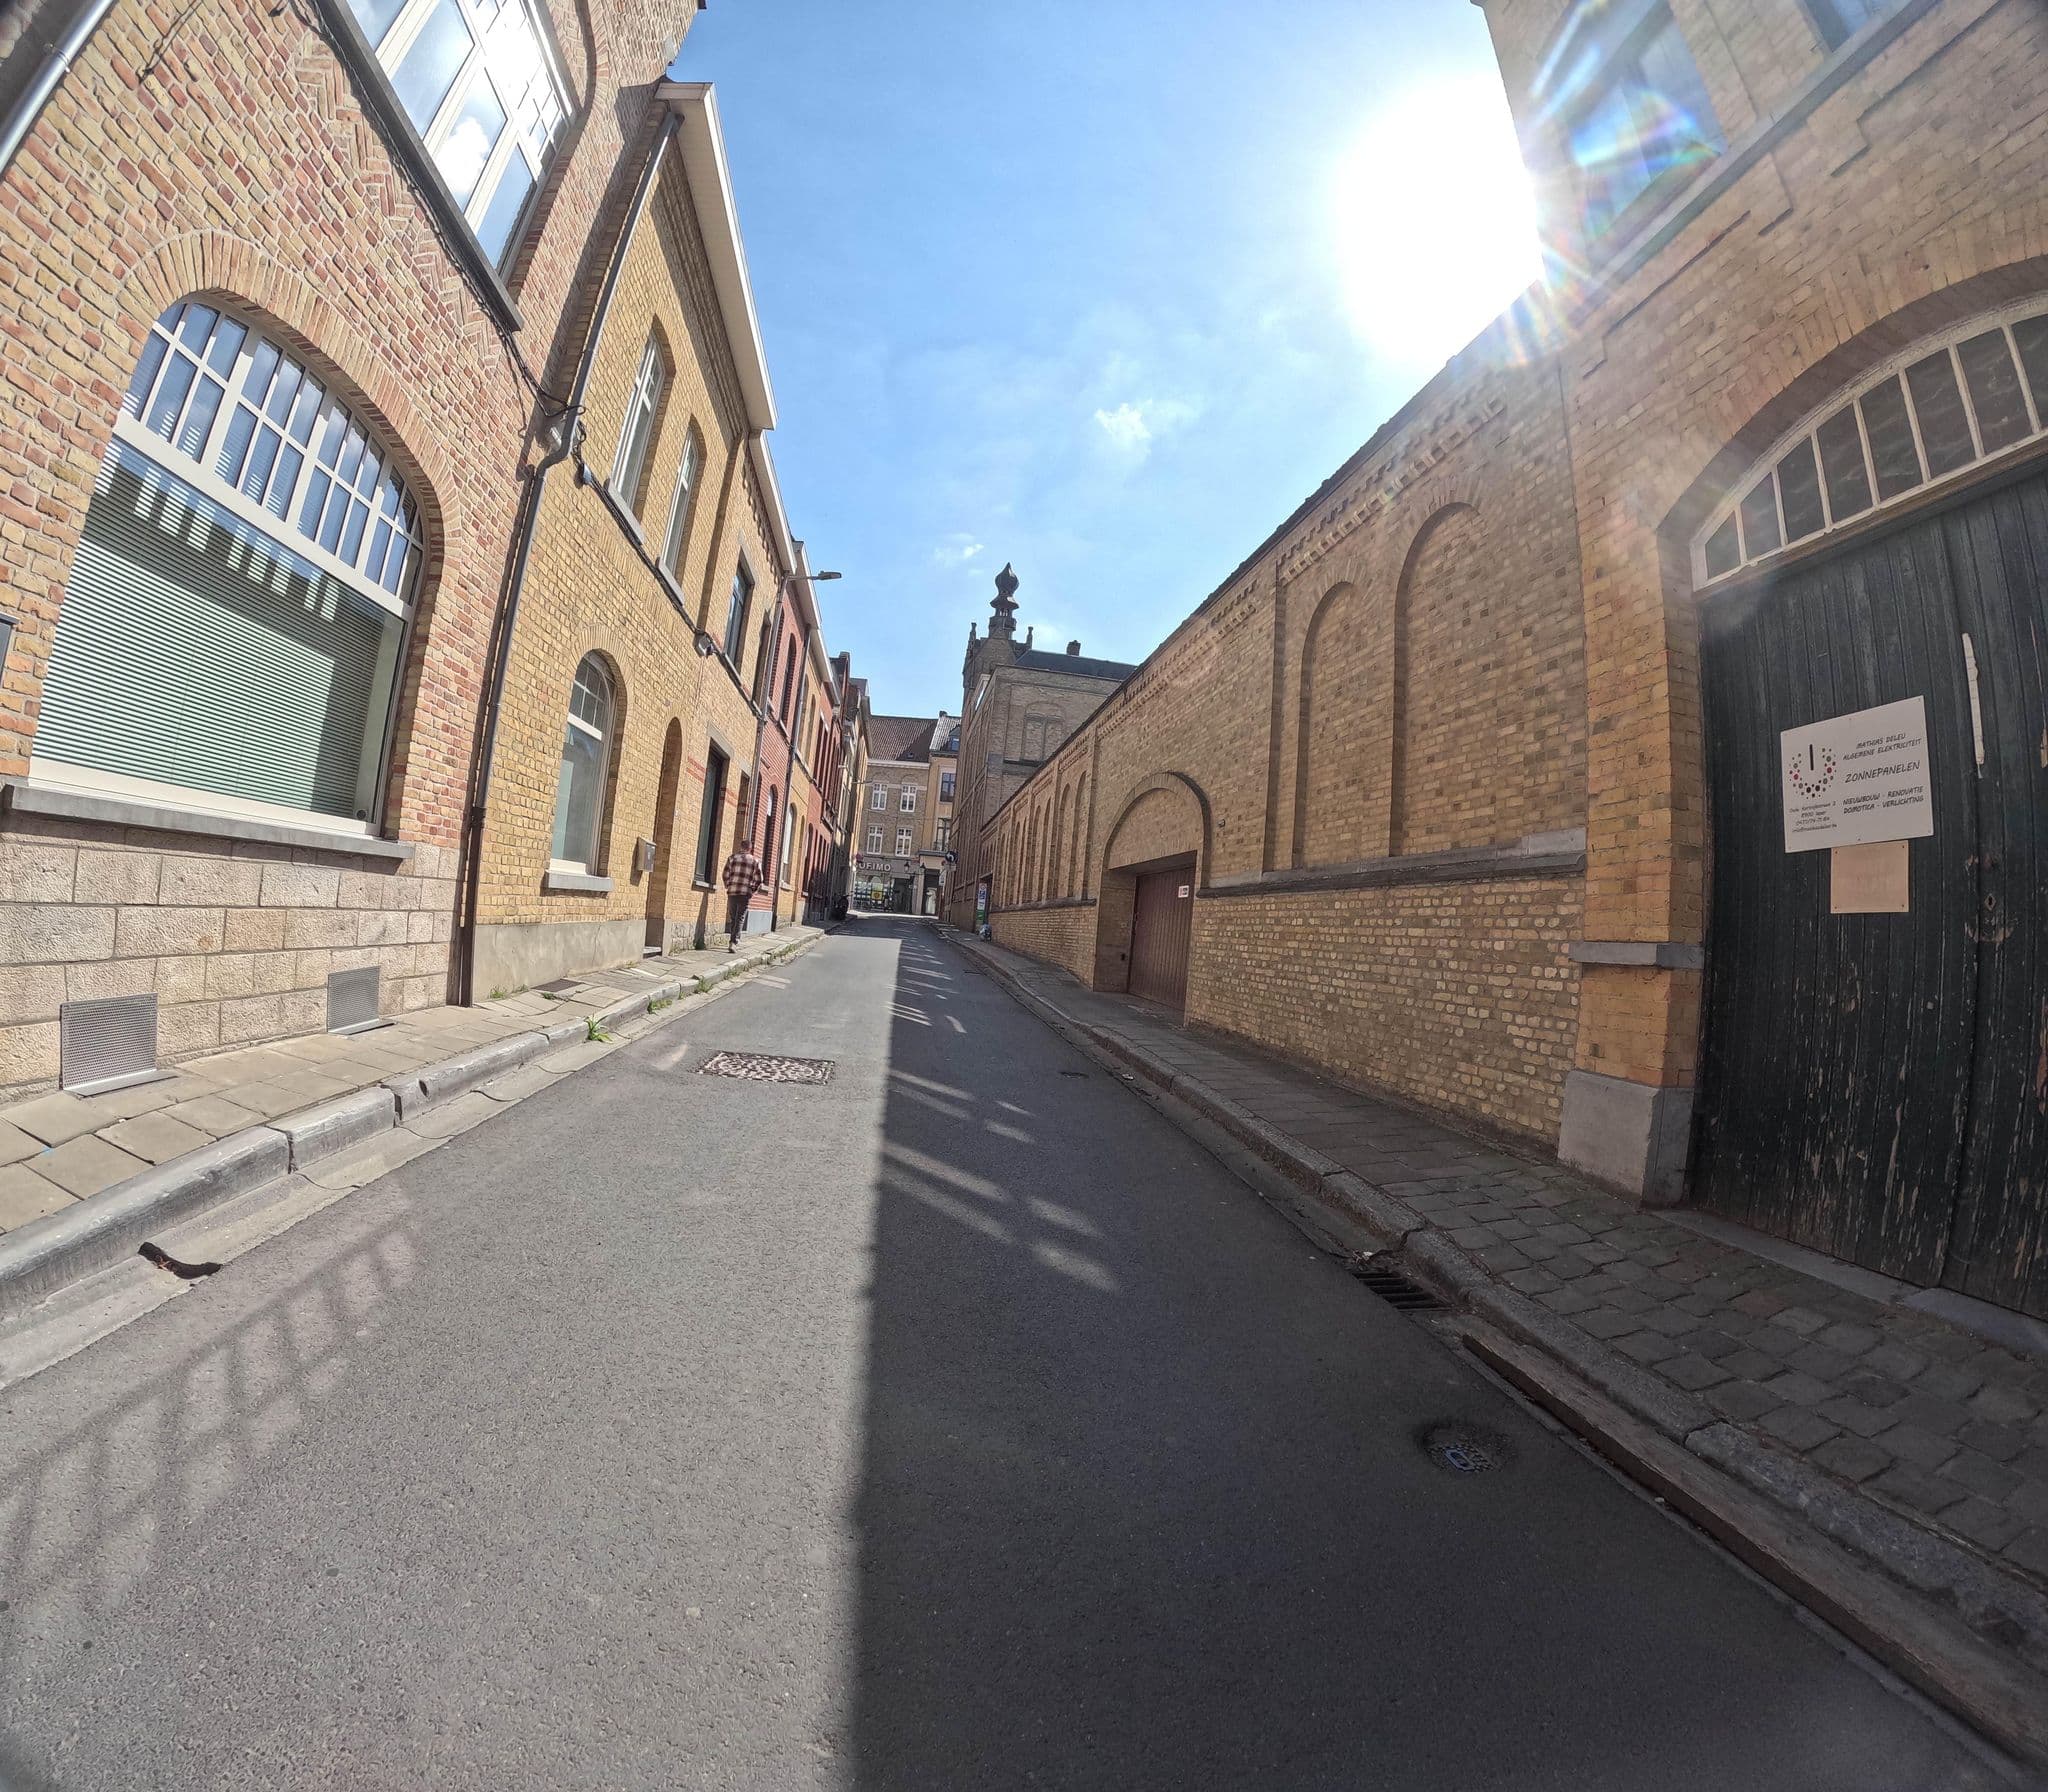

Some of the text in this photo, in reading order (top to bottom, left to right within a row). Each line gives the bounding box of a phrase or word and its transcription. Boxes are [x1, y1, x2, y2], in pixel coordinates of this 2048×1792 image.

[1843, 738, 1922, 760] ALGEMENE ELEKTRICITEIT
[1856, 738, 1883, 749] MATHIAS
[1845, 760, 1920, 783] ZONNEPANELEN
[1843, 793, 1881, 805] NIEUWBOUW
[1888, 786, 1924, 797] RENOVATIE
[1843, 803, 1875, 814] DOMOTICA
[1882, 795, 1924, 808] VERLICHTING
